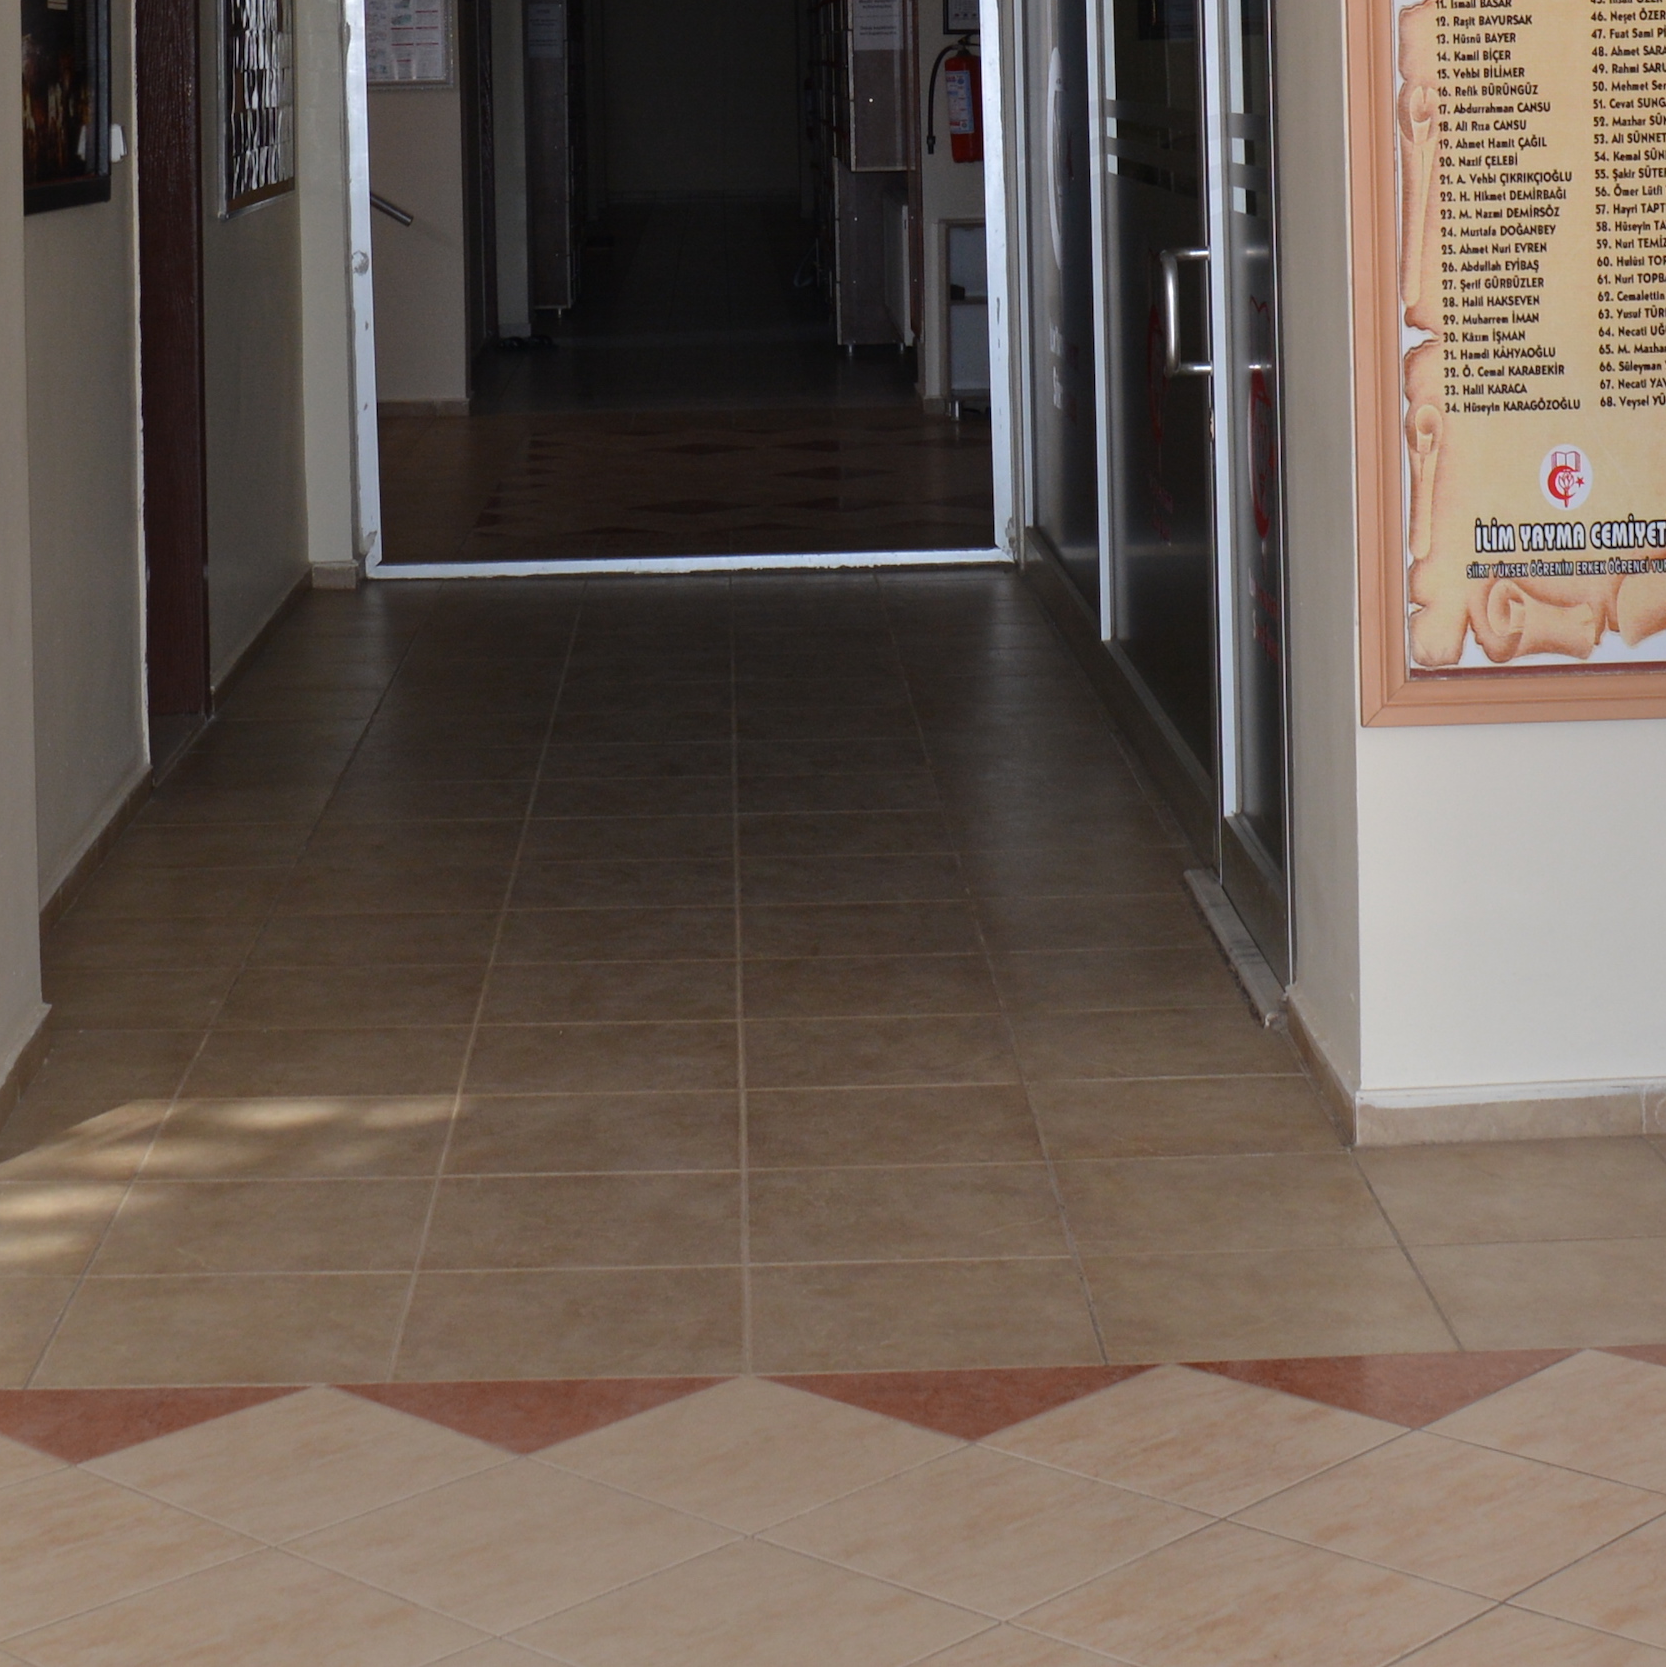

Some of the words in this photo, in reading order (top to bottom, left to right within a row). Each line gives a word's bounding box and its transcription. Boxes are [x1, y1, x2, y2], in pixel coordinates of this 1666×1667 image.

[1435, 16, 1449, 27] 12.
[1591, 11, 1607, 22] 46.
[1610, 10, 1636, 24] Neşet
[1436, 33, 1449, 45] 13.
[1453, 33, 1481, 44] Hüsnü
[1485, 32, 1516, 44] BAYER
[1591, 46, 1608, 57] 48.
[1610, 45, 1640, 57] Ahmet
[1592, 63, 1608, 74] 49.
[1611, 62, 1639, 74] Rahmi
[1593, 81, 1607, 92] 50.
[1611, 80, 1649, 92] Mehmet
[1438, 104, 1451, 115] 17.
[1453, 101, 1514, 115] Abdurrahman
[1517, 101, 1551, 113] CANSU
[1593, 98, 1606, 109] 51.
[1609, 98, 1634, 109] Cevat
[1441, 226, 1457, 237] 24.
[1500, 222, 1556, 236] DOĞANBEY
[1441, 244, 1456, 255] 25.
[1459, 243, 1489, 255] Ahmet
[1491, 243, 1511, 254] Nuri
[1515, 242, 1547, 253] EVREN
[1597, 274, 1611, 285] 61.
[1615, 273, 1634, 284] Nuri
[1443, 314, 1459, 325] 29.
[1512, 310, 1539, 324] İMAN
[1444, 384, 1459, 396] 33.
[1463, 384, 1484, 395] Halil
[1487, 383, 1527, 395] KARACA
[1445, 402, 1460, 413] 34.
[1463, 401, 1500, 416] Hüseyin
[1503, 396, 1581, 412] KARAGÖZOĞLU
[1600, 396, 1616, 407] 68.
[1619, 395, 1649, 410] Veysel
[1475, 518, 1515, 553] İLİM
[1519, 521, 1586, 551] YAYMA
[1491, 560, 1528, 578] YÜKSEK
[1530, 558, 1574, 577] ÖĞRENİM
[1576, 560, 1607, 576] ERKEK
[1608, 556, 1649, 574] ÖĞRENCİ
